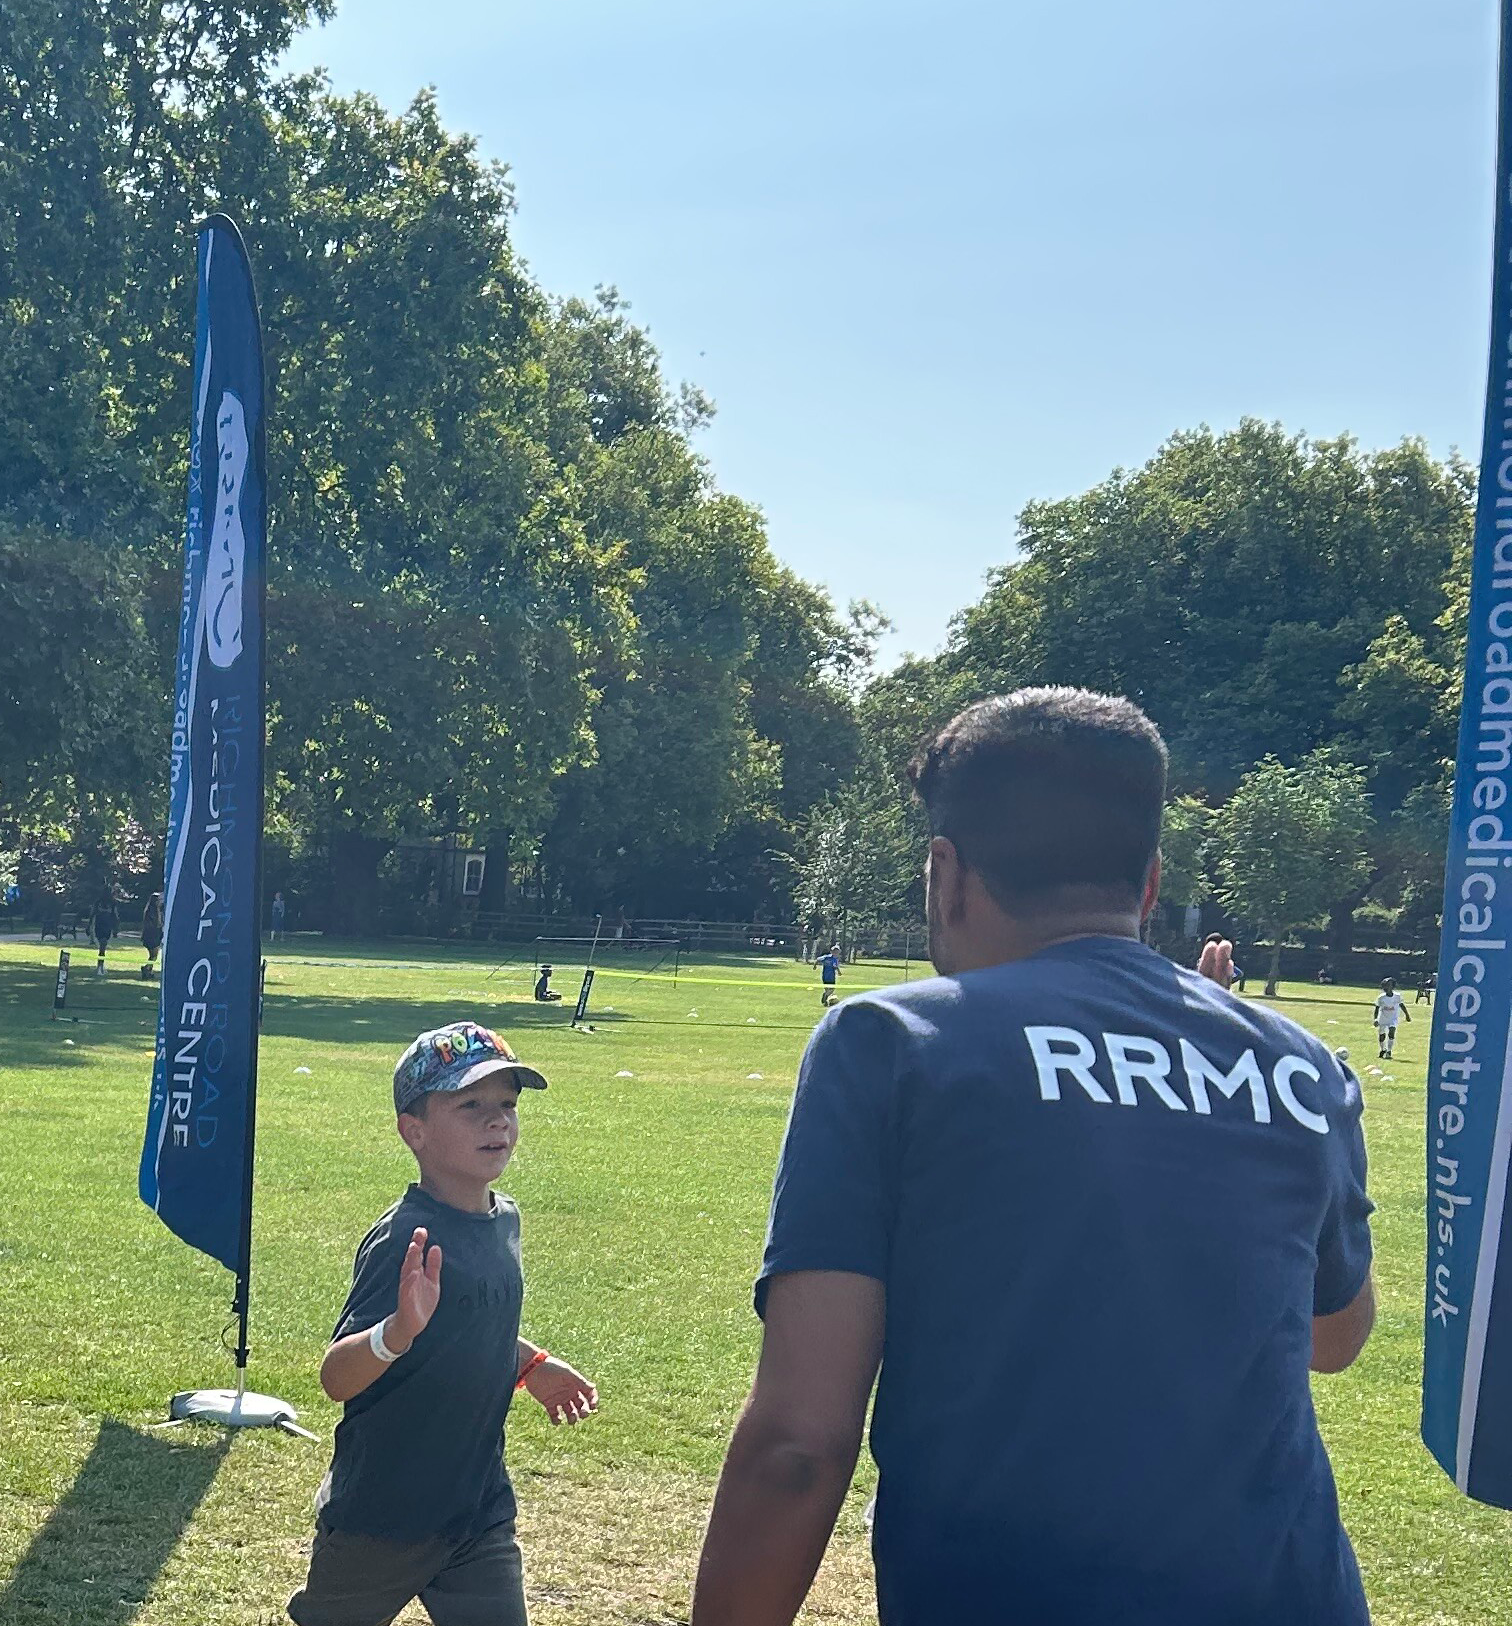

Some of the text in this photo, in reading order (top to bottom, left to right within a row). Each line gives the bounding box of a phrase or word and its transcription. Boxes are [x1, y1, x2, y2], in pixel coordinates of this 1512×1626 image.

[171, 957, 212, 1148] CENTRE
[196, 1003, 230, 1148] ROAD
[1023, 1025, 1330, 1135] RRMC
